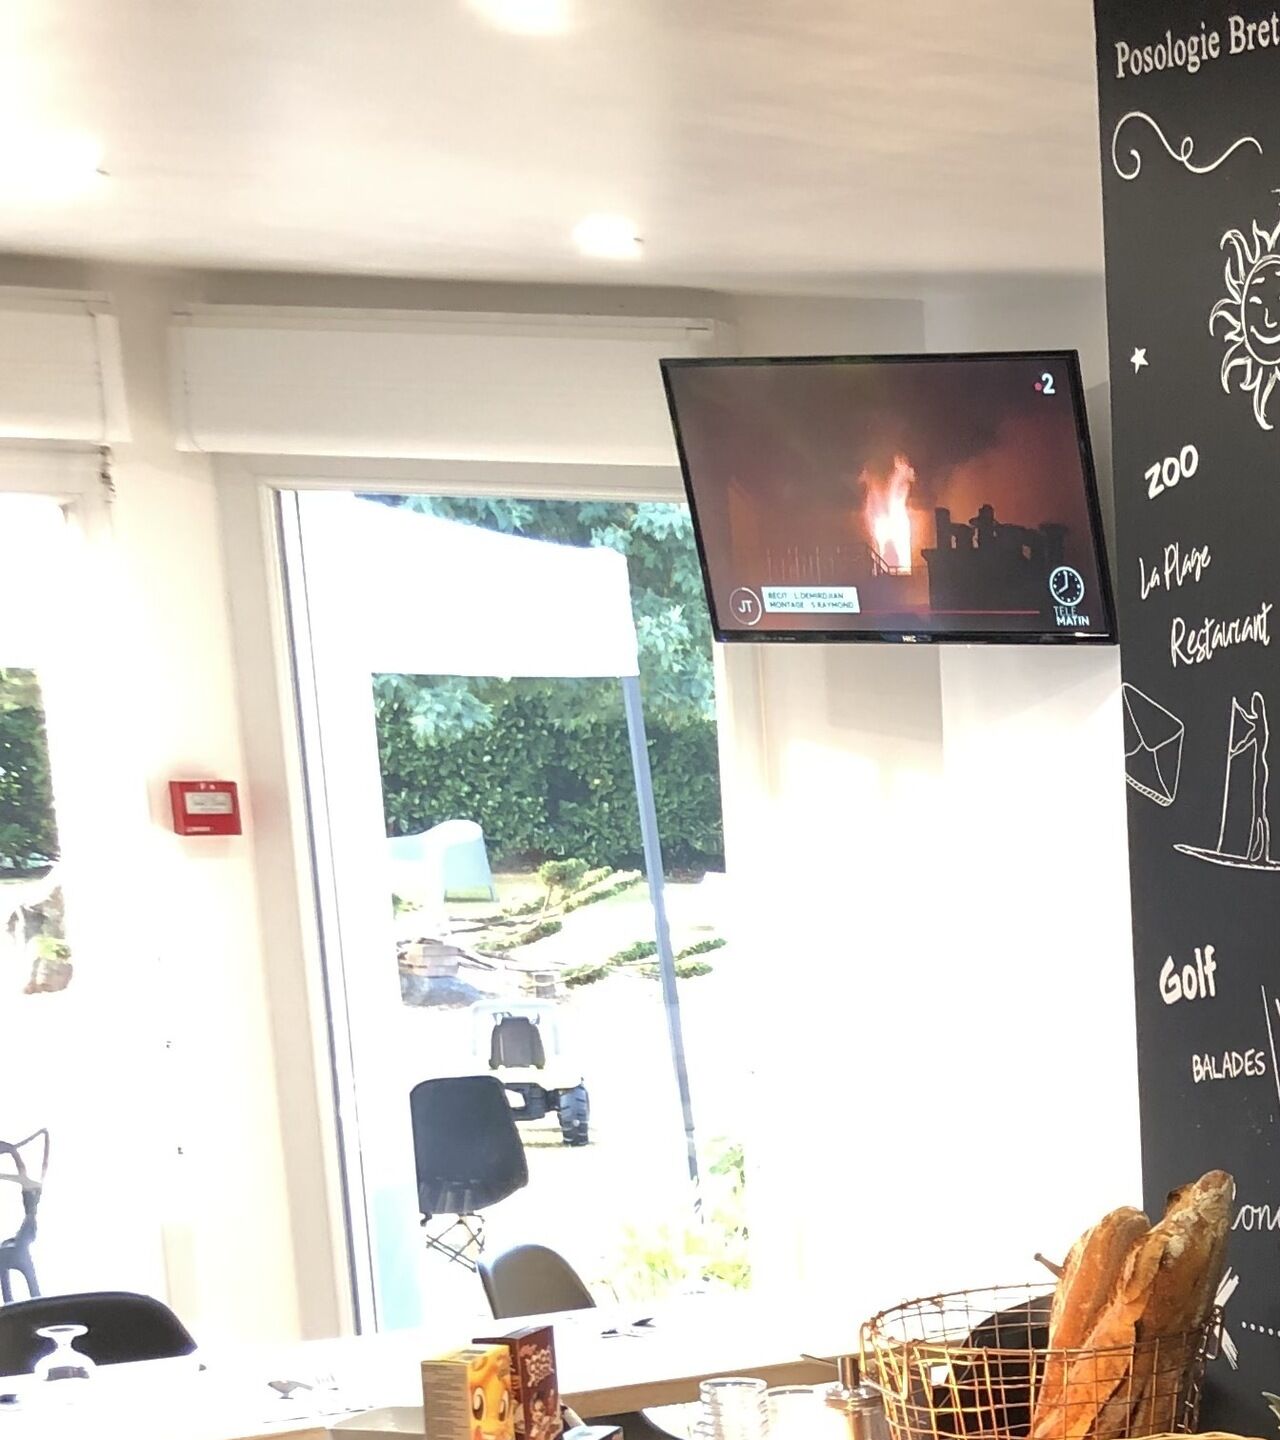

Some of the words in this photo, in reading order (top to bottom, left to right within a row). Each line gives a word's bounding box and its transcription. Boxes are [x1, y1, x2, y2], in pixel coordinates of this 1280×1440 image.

[1115, 22, 1221, 78] Posologie
[1041, 372, 1056, 395] 2
[1144, 444, 1199, 500] ZOO
[1139, 556, 1160, 601] La
[1164, 542, 1212, 592] Plage
[738, 600, 753, 613] JT
[1056, 615, 1090, 627] MATIN
[1170, 602, 1273, 668] Restaurant
[1159, 944, 1217, 1005] Golf
[1192, 1048, 1266, 1083] BALADES
